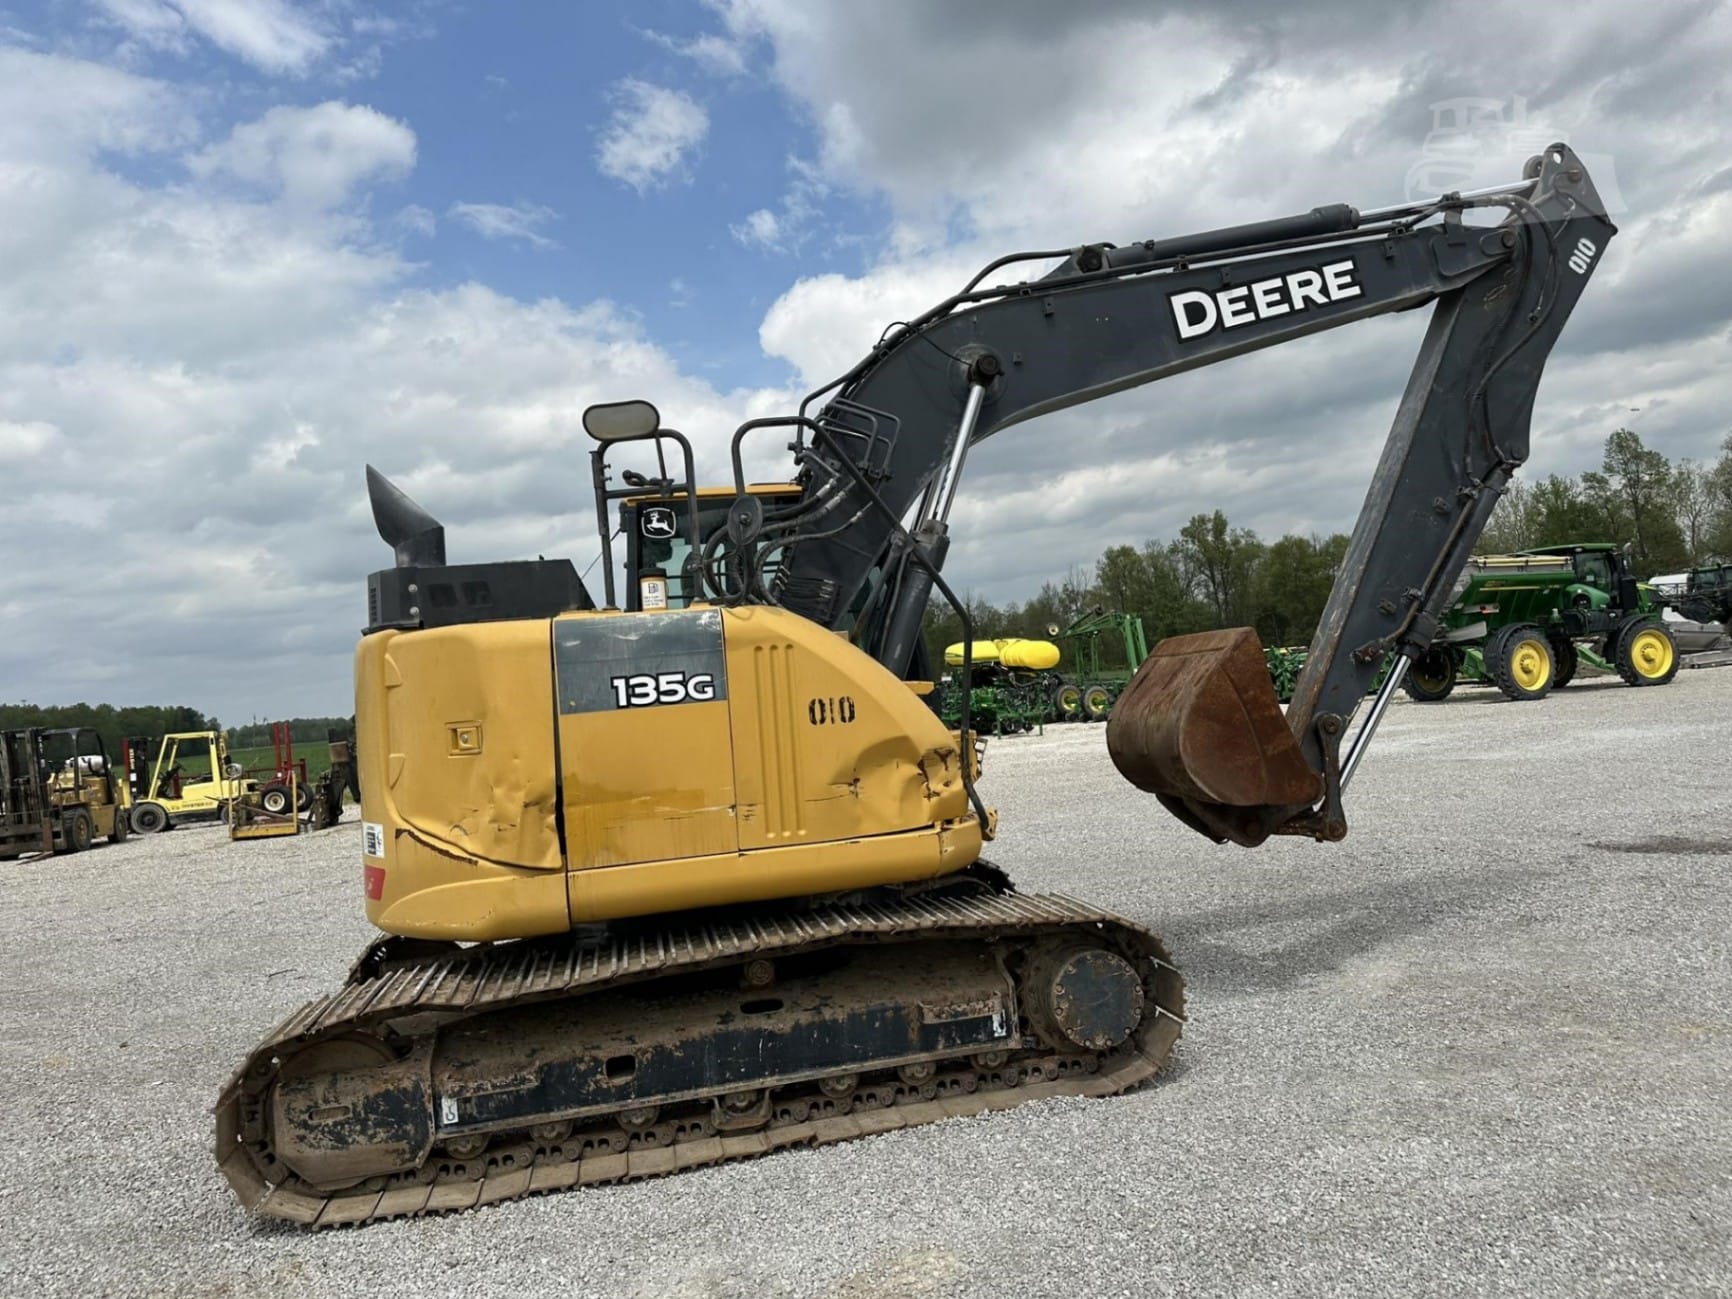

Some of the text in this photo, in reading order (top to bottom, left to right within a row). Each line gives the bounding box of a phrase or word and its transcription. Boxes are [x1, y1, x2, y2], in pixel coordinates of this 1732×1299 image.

[1568, 238, 1596, 274] 010
[1169, 259, 1362, 340] DEERE
[611, 672, 714, 708] 135G
[808, 696, 856, 725] 010
